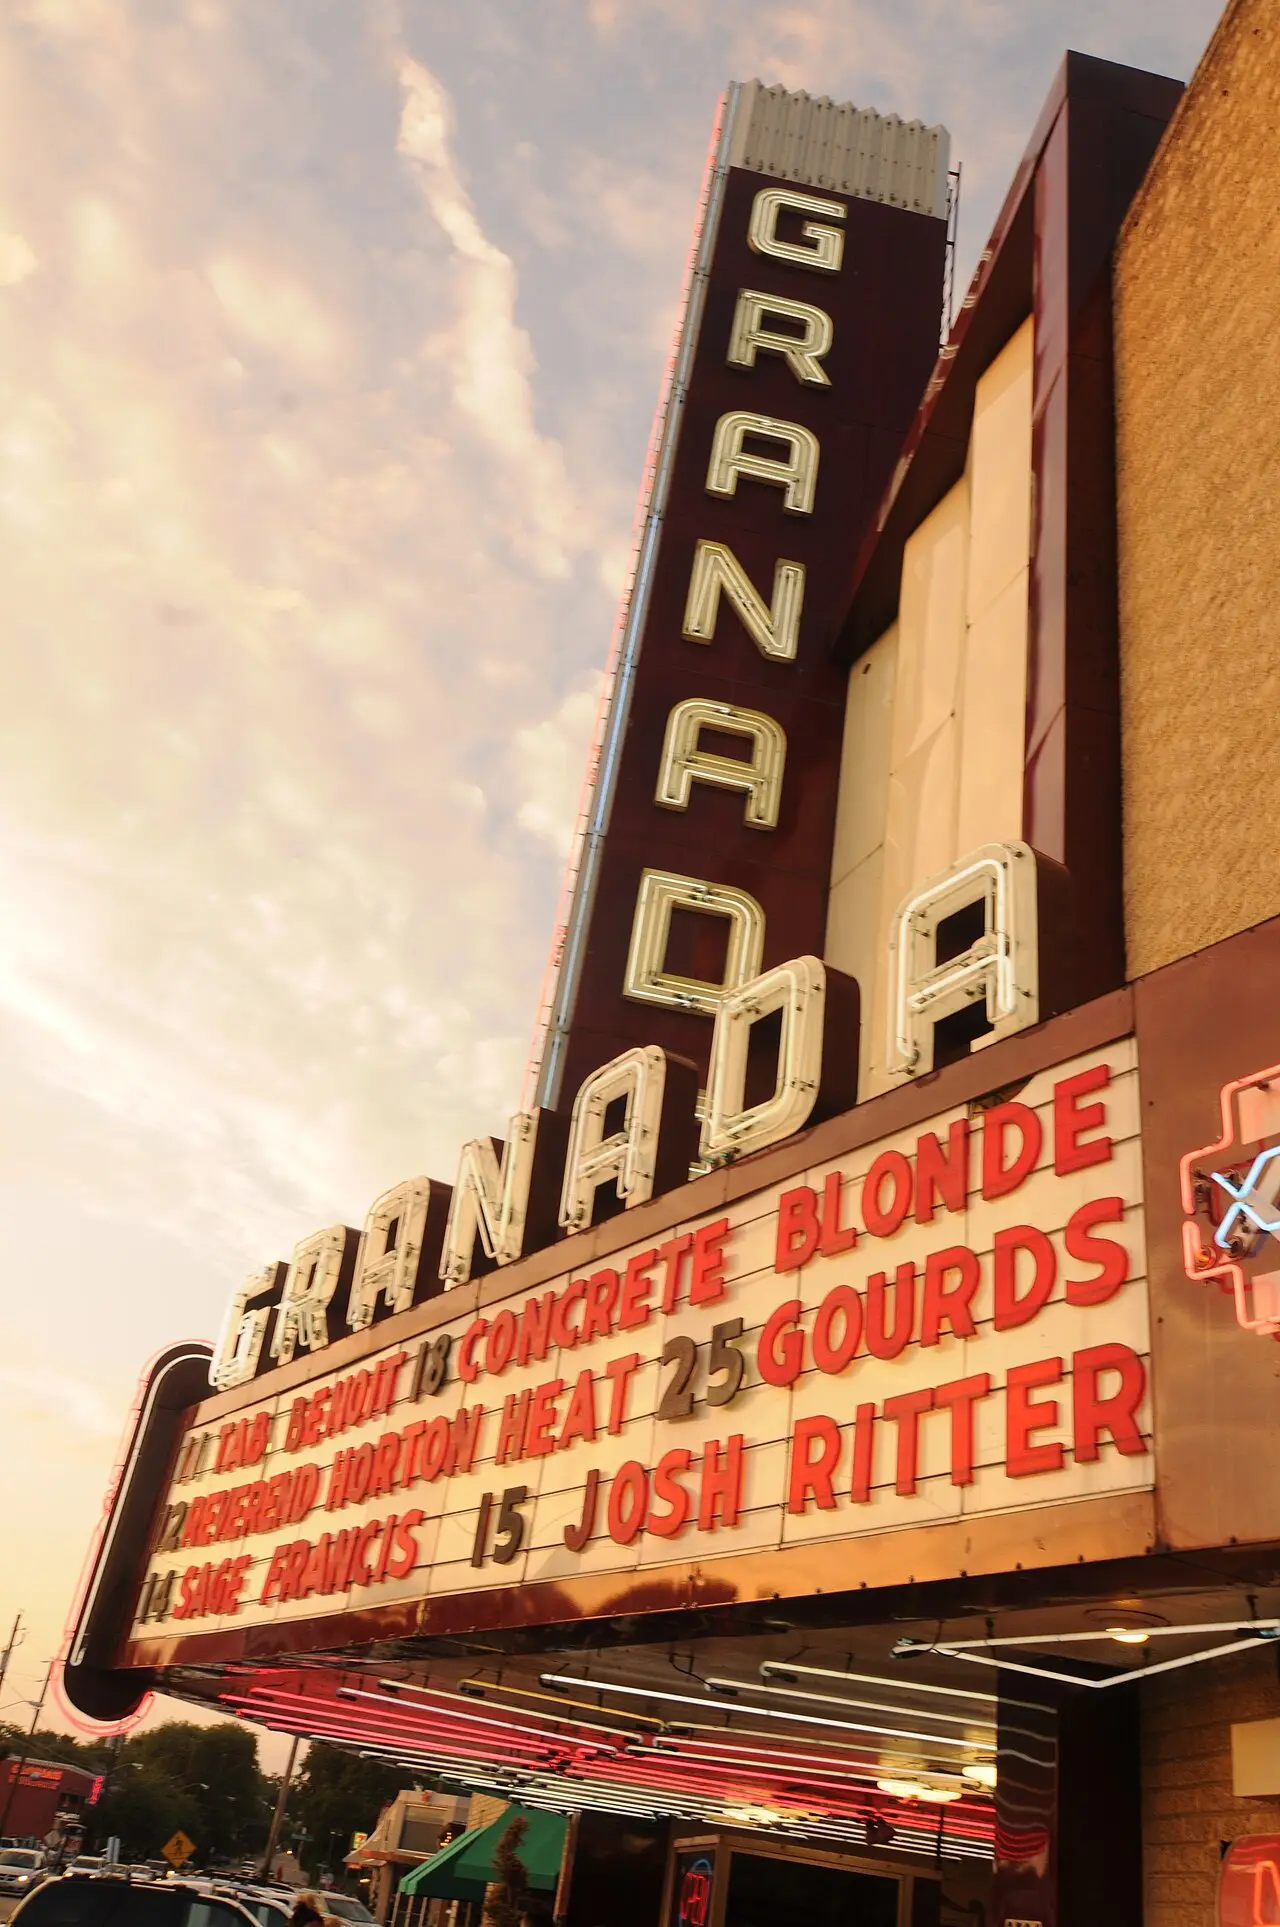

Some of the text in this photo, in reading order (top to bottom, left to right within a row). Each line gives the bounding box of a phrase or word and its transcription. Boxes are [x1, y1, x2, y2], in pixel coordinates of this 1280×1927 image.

[622, 186, 848, 1018] GRANAD
[208, 839, 1041, 1391] GRANADA
[213, 1412, 271, 1474] TAB
[285, 1351, 407, 1452] BENOIT
[409, 1334, 452, 1402] 18
[457, 1218, 729, 1383] CONCRETE
[775, 1064, 1112, 1274] BLONDE
[138, 1343, 1147, 1624] 14 SAGE FRANCIS 15 JOSH RITTER
[153, 1197, 1129, 1552] 12 REVEREND HORTON HEAT 25 GOURDS
